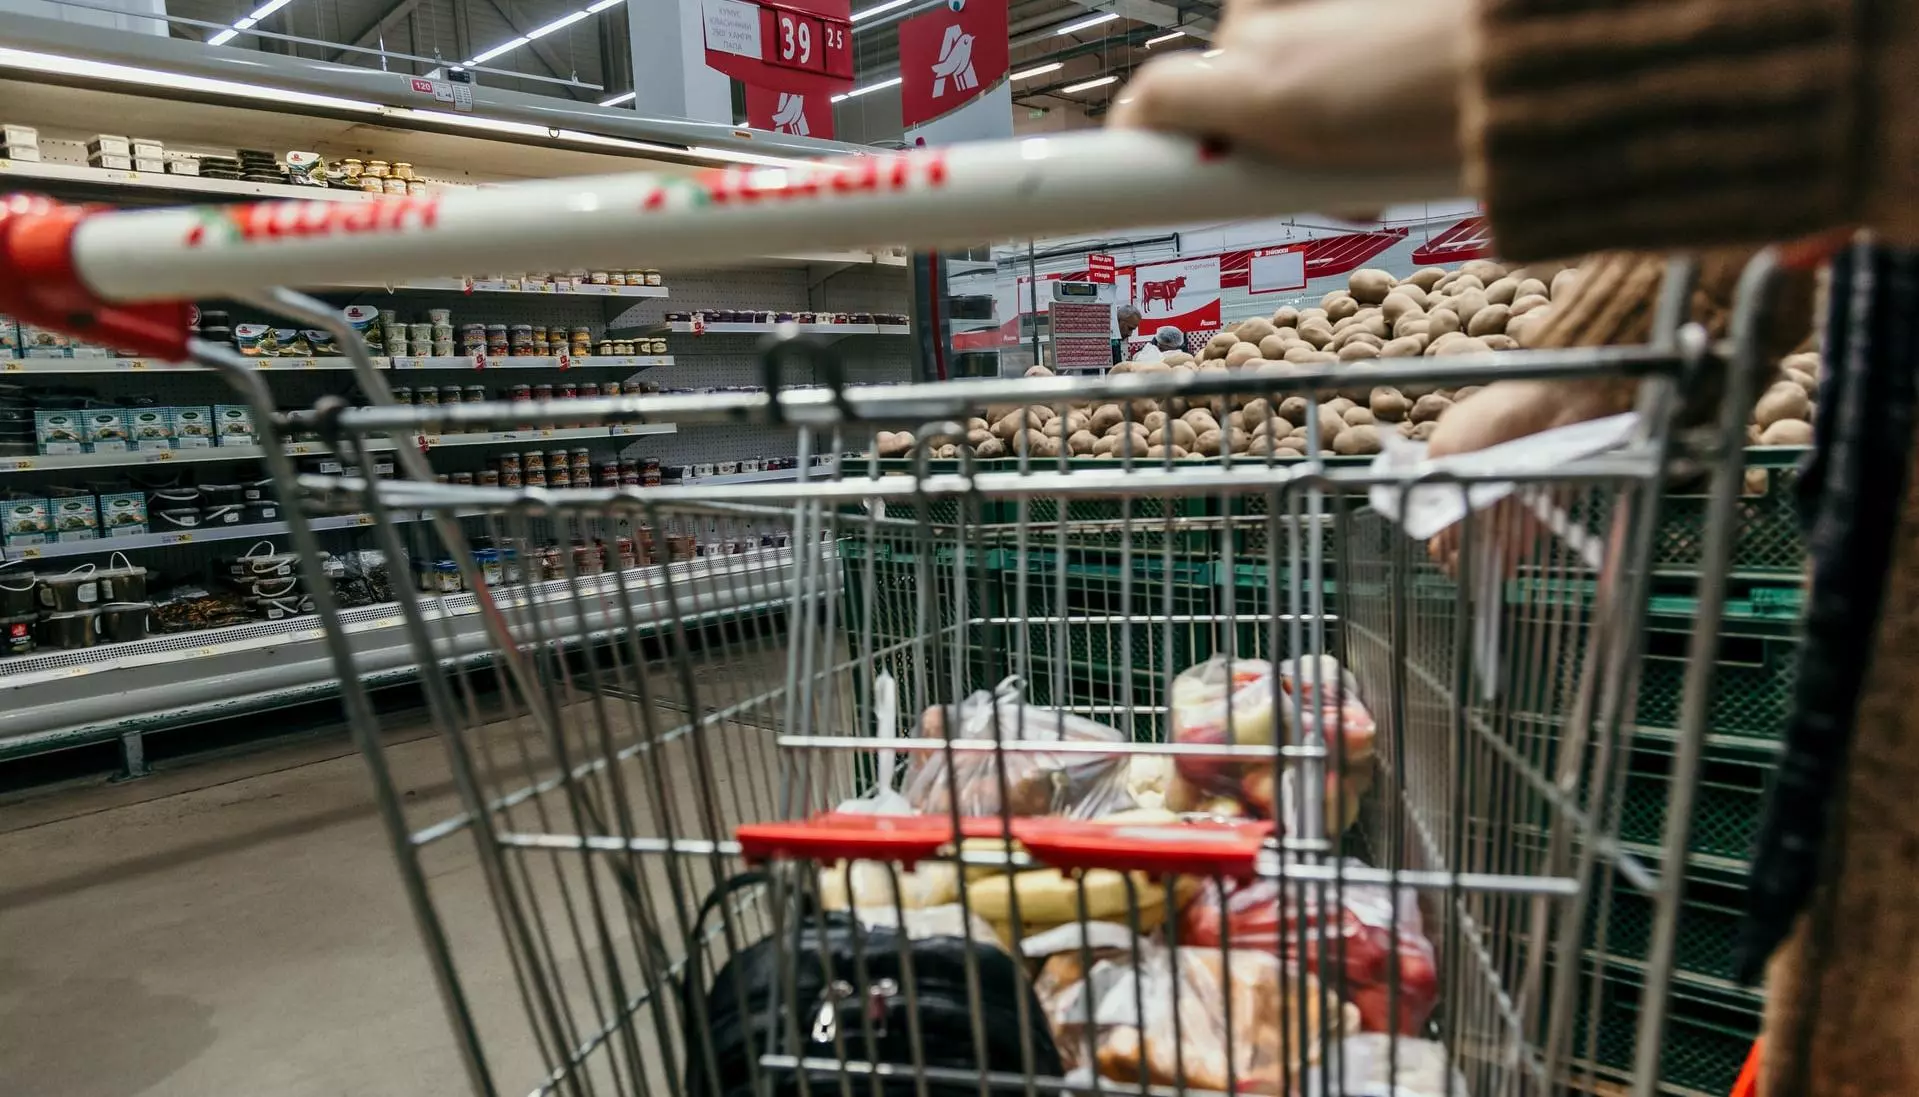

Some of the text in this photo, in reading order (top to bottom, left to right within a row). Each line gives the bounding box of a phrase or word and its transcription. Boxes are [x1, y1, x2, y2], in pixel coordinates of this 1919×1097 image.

[782, 17, 843, 64] 39 25
[416, 82, 431, 91] 120
